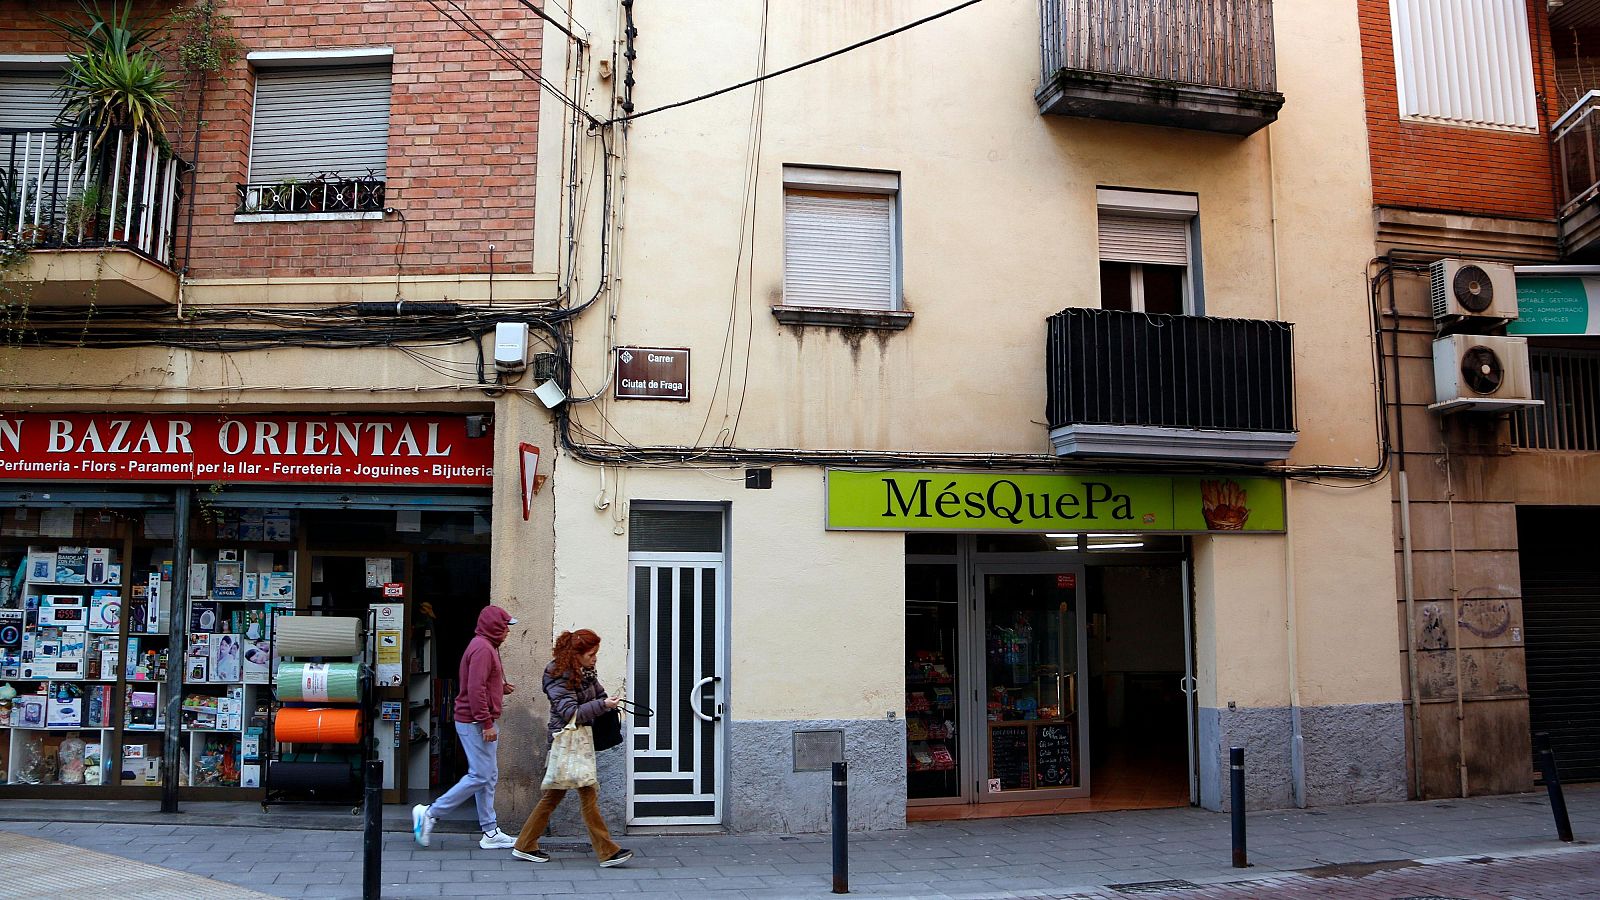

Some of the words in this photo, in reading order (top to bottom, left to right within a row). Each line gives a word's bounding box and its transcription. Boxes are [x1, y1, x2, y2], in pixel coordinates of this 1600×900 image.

[647, 353, 674, 363] Carrer
[621, 379, 647, 388] Ciutat
[648, 380, 659, 389] de
[660, 381, 683, 391] Fraga
[46, 419, 194, 454] BAZAR
[218, 420, 452, 456] ORIENTAL
[0, 459, 70, 471] Perfumeria
[82, 460, 117, 472] Flors
[129, 461, 194, 473] Parament
[197, 463, 220, 475] per
[223, 461, 235, 473] la
[239, 462, 262, 474] llar
[273, 463, 342, 475] Ferreteria
[353, 463, 420, 478] Joguines
[432, 464, 494, 479] Bijuteria
[881, 478, 1135, 524] MésQuePa
